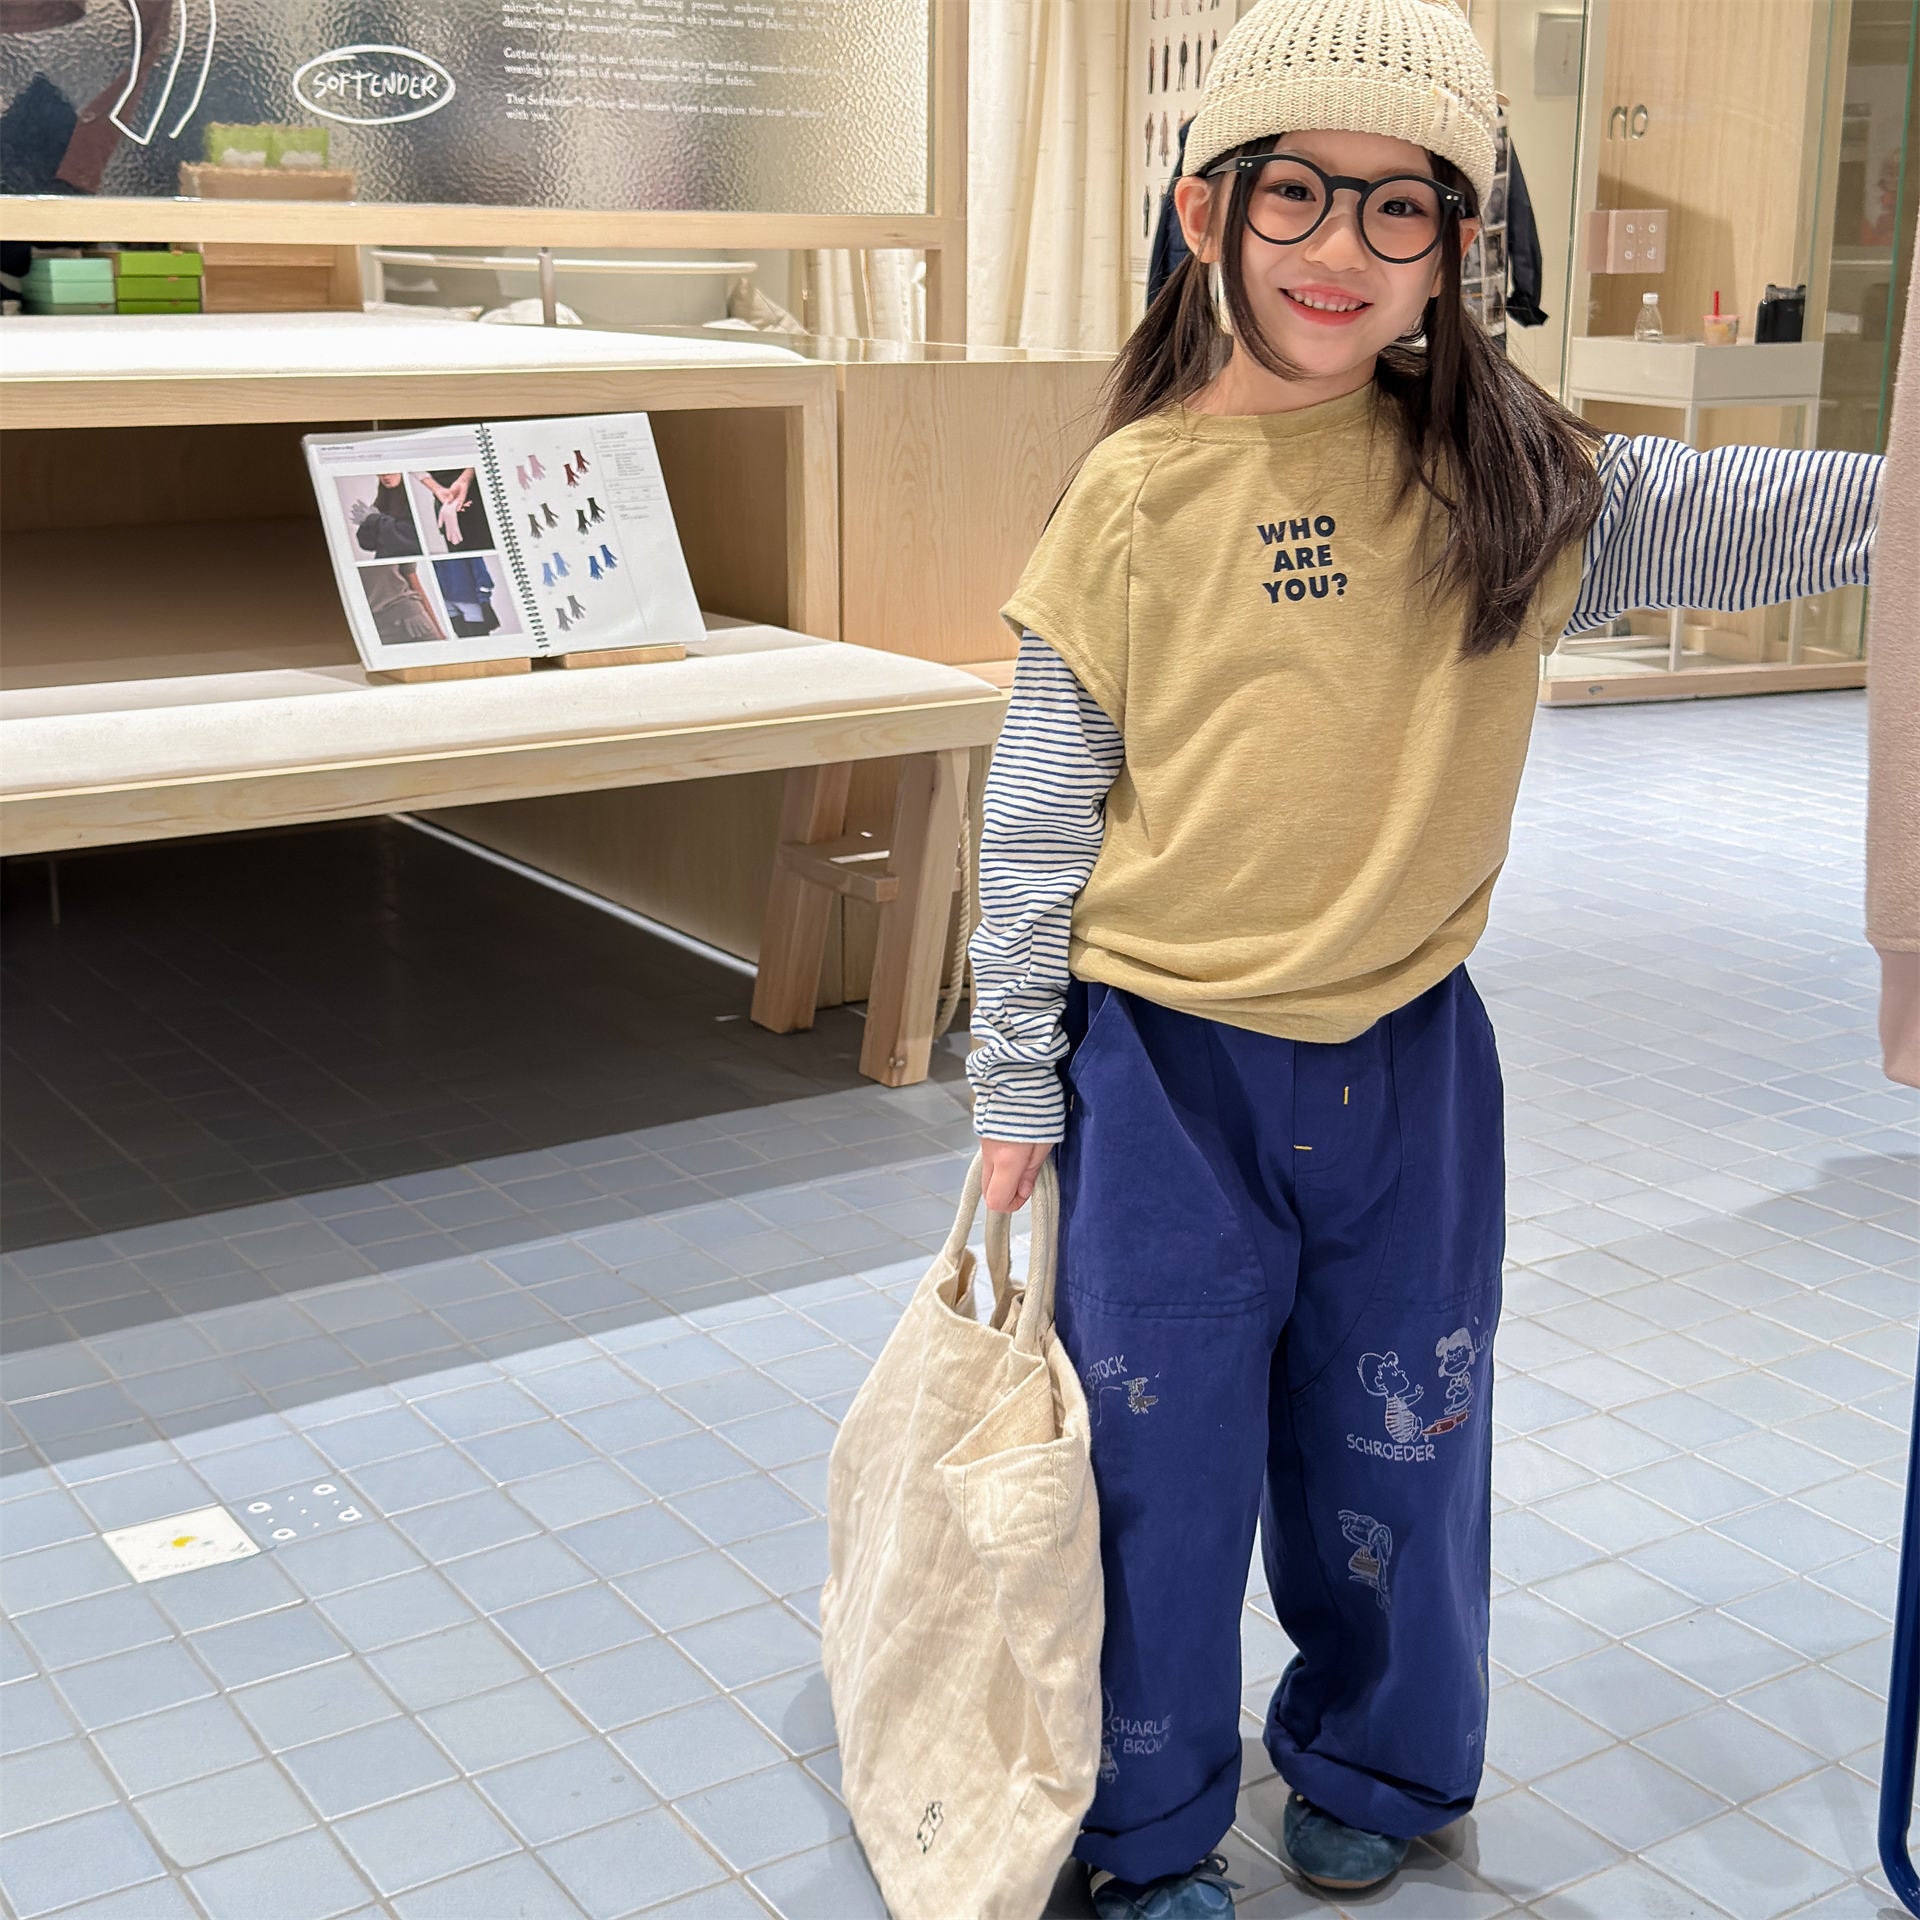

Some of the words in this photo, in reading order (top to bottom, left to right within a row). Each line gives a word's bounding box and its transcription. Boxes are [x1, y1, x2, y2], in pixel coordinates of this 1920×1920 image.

[313, 69, 439, 100] SOFTENDER
[1256, 515, 1336, 545] WHO
[1273, 544, 1333, 573] ARE
[1262, 572, 1348, 604] YOU?
[1346, 1433, 1436, 1463] SCHROEDER
